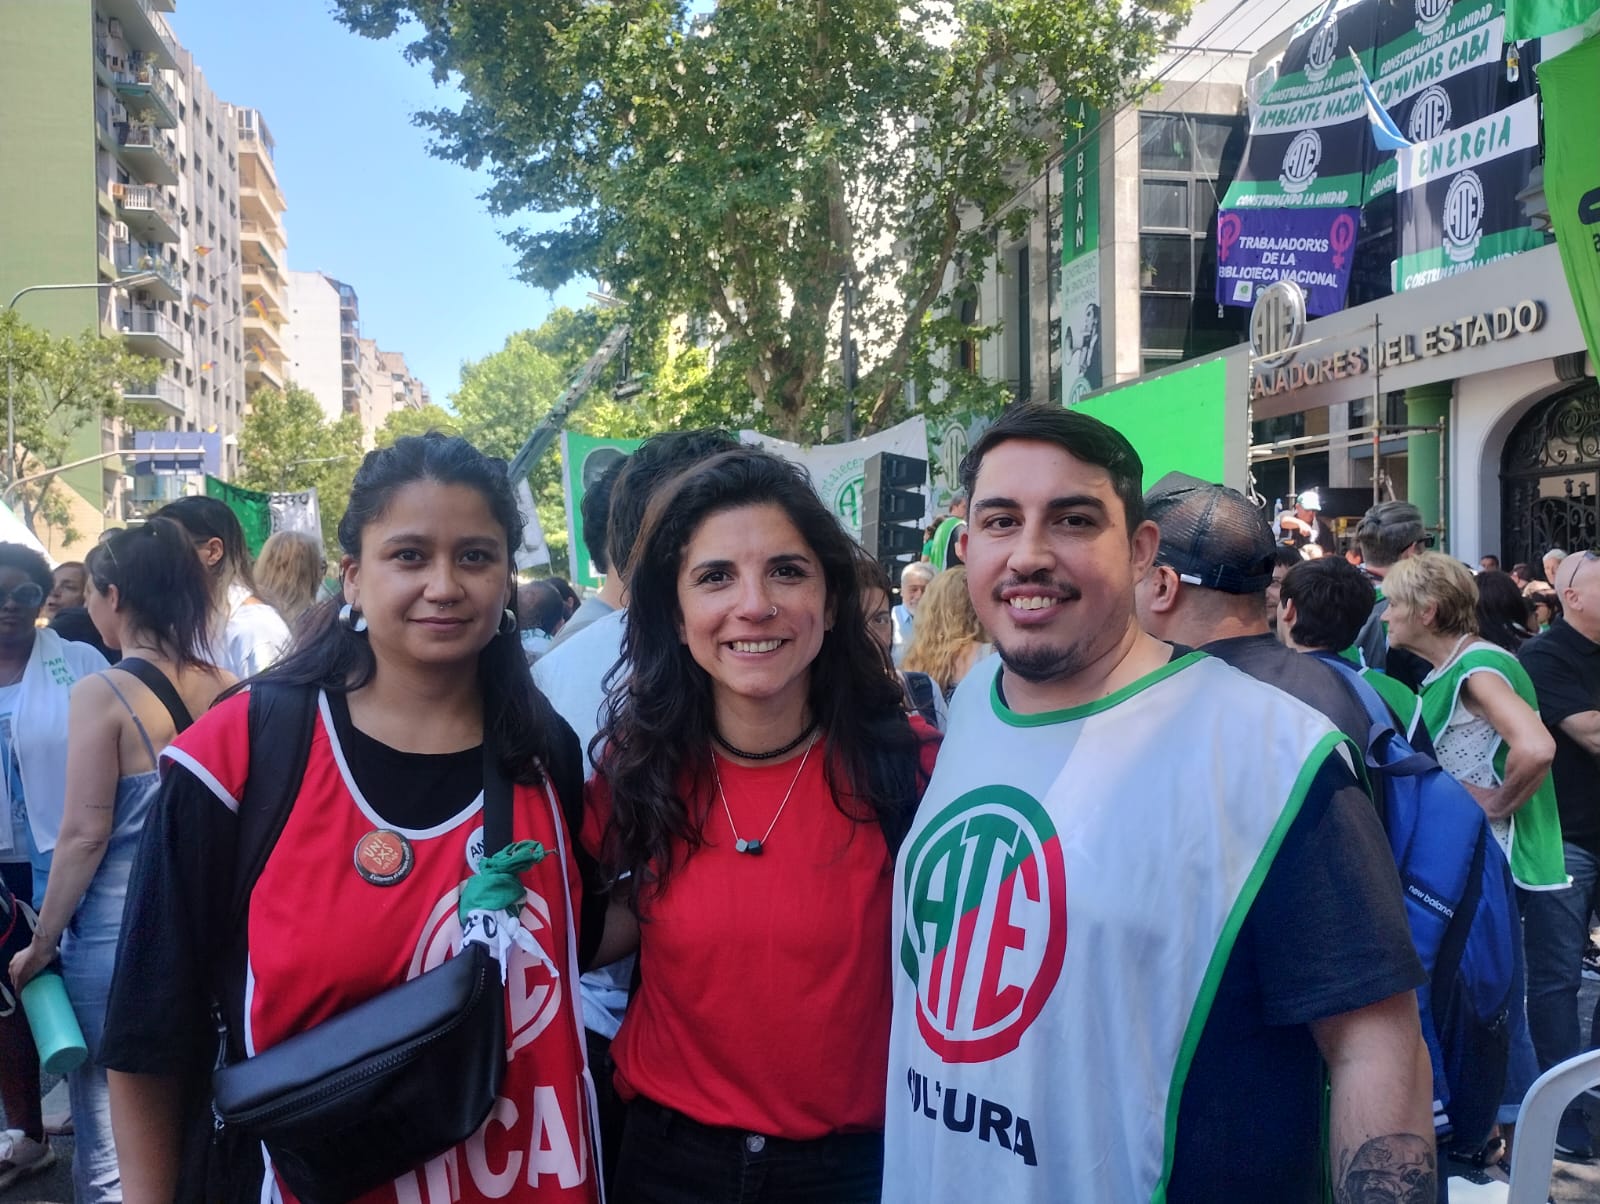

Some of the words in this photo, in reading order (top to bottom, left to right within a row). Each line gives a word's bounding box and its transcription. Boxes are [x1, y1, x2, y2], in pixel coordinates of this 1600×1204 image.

[1446, 23, 1456, 41] LA
[1458, 4, 1493, 31] UNIDAD
[1377, 52, 1444, 106] COMUNAS
[1449, 29, 1490, 71] CABA
[1257, 102, 1322, 128] AMBIENTE
[1418, 115, 1511, 178] ENERGIA
[1239, 236, 1329, 252] TRABAJADORXS
[1262, 252, 1279, 265] DE
[1280, 253, 1296, 266] LA
[1219, 266, 1279, 281] BBLIOTECA
[1280, 269, 1338, 288] NACIONAL
[1422, 299, 1540, 357] ESTADO
[1408, 884, 1425, 899] new
[912, 812, 1041, 1031] ATE
